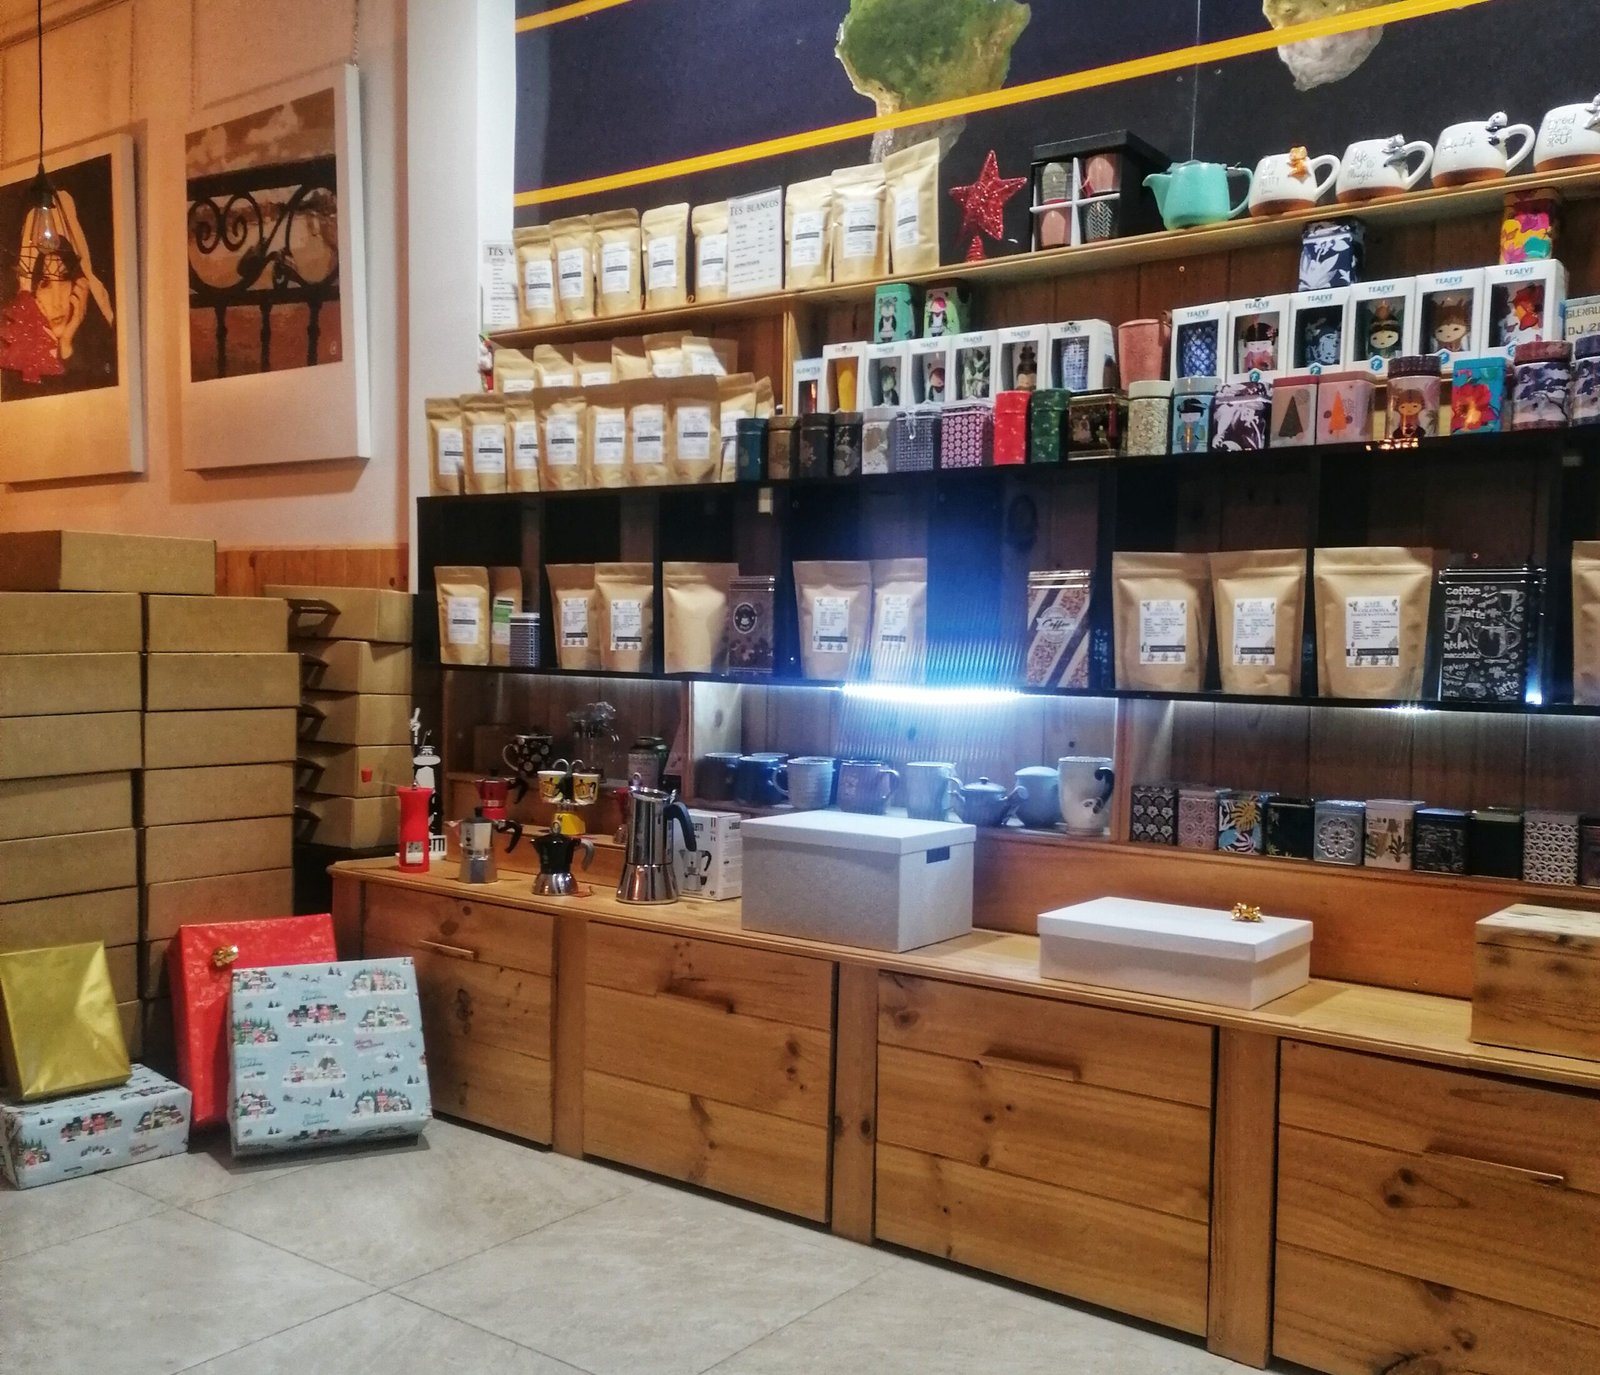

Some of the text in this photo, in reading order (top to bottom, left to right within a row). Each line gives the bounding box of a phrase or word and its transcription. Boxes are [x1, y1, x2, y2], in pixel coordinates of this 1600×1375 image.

[746, 200, 780, 214] BLANCOS
[1445, 586, 1481, 596] coffee
[1461, 608, 1486, 620] latte
